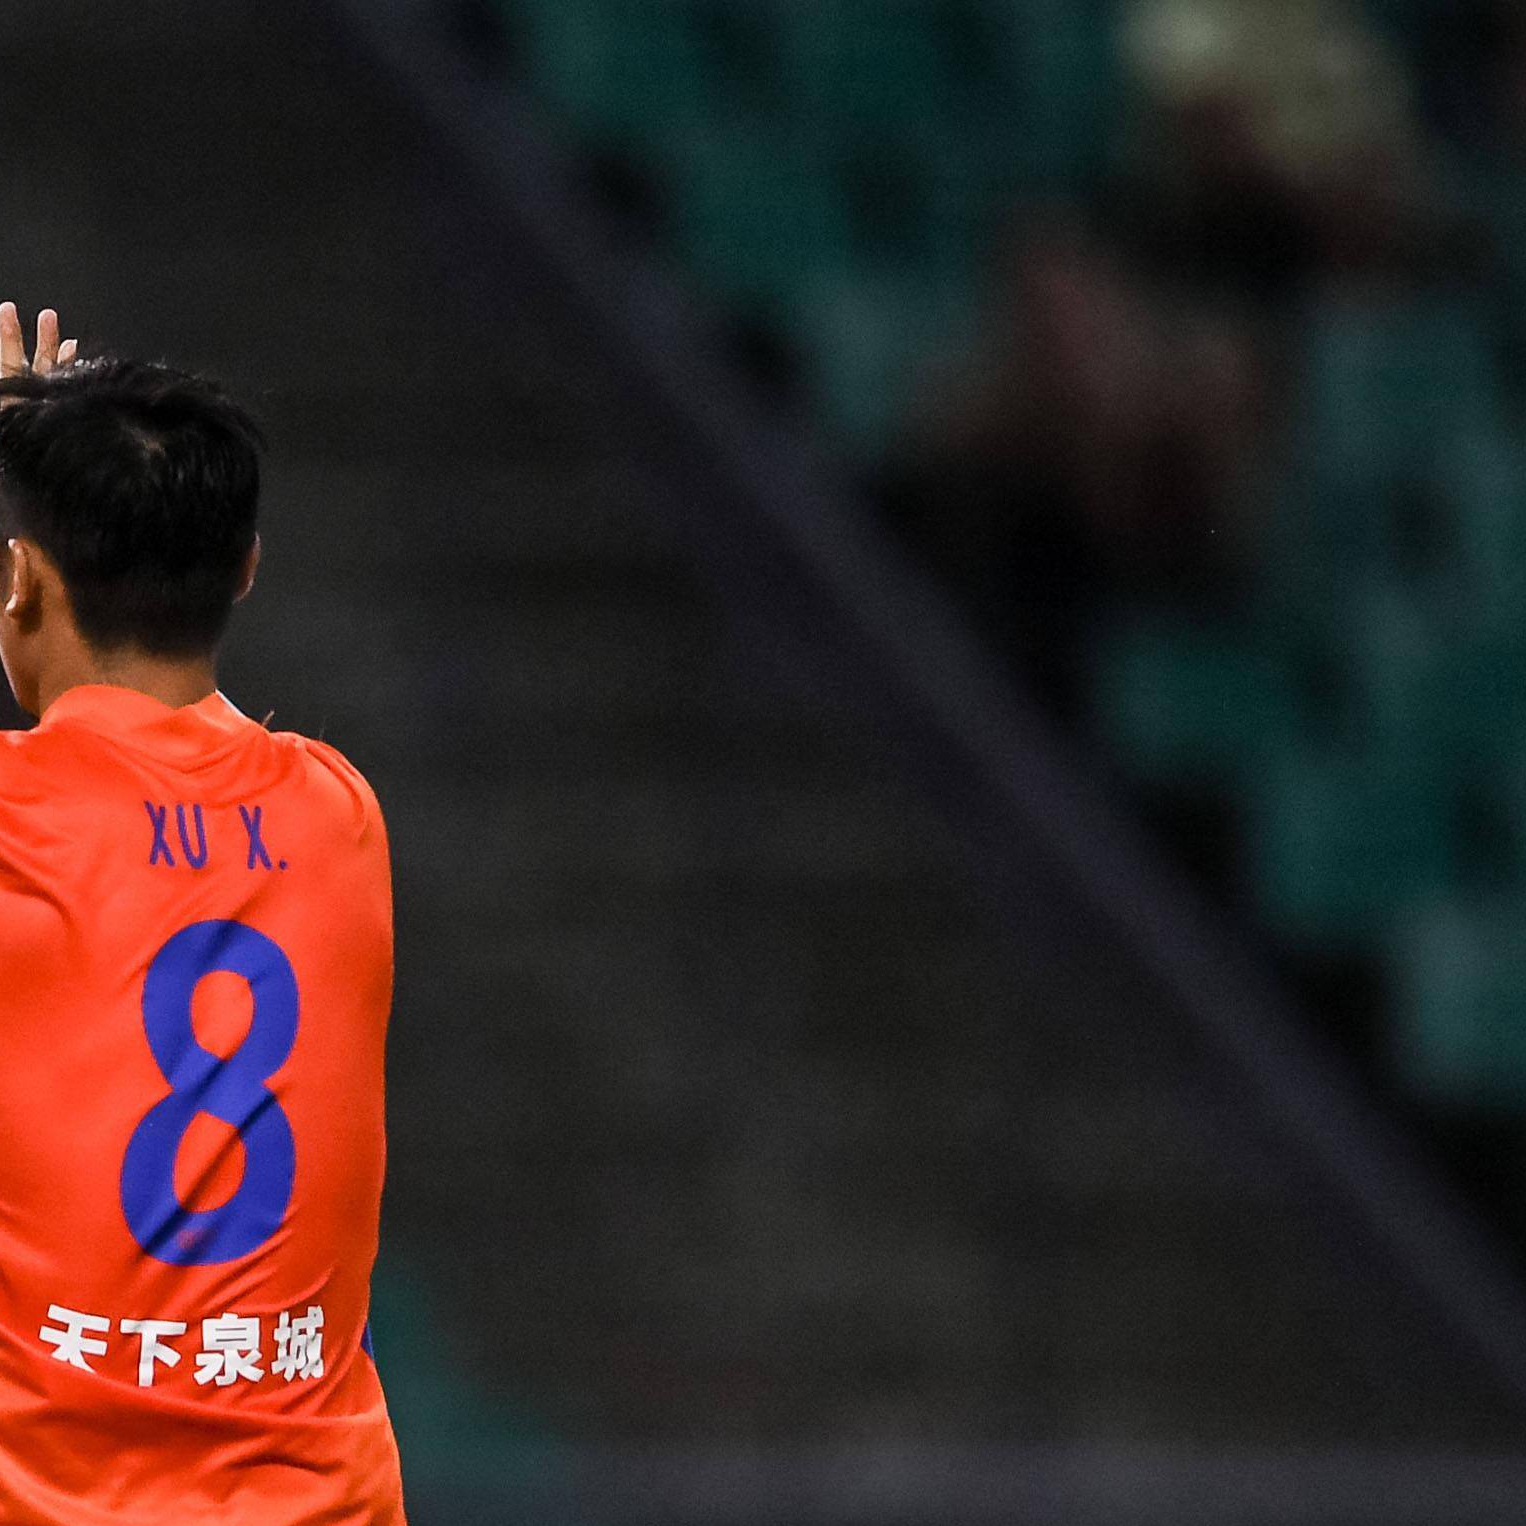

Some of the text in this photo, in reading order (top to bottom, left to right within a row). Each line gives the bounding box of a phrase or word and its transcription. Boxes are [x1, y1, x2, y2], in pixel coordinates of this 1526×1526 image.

[143, 800, 288, 871] XU X.
[119, 918, 301, 1267] 8
[39, 1303, 327, 1388] 天下泉城
